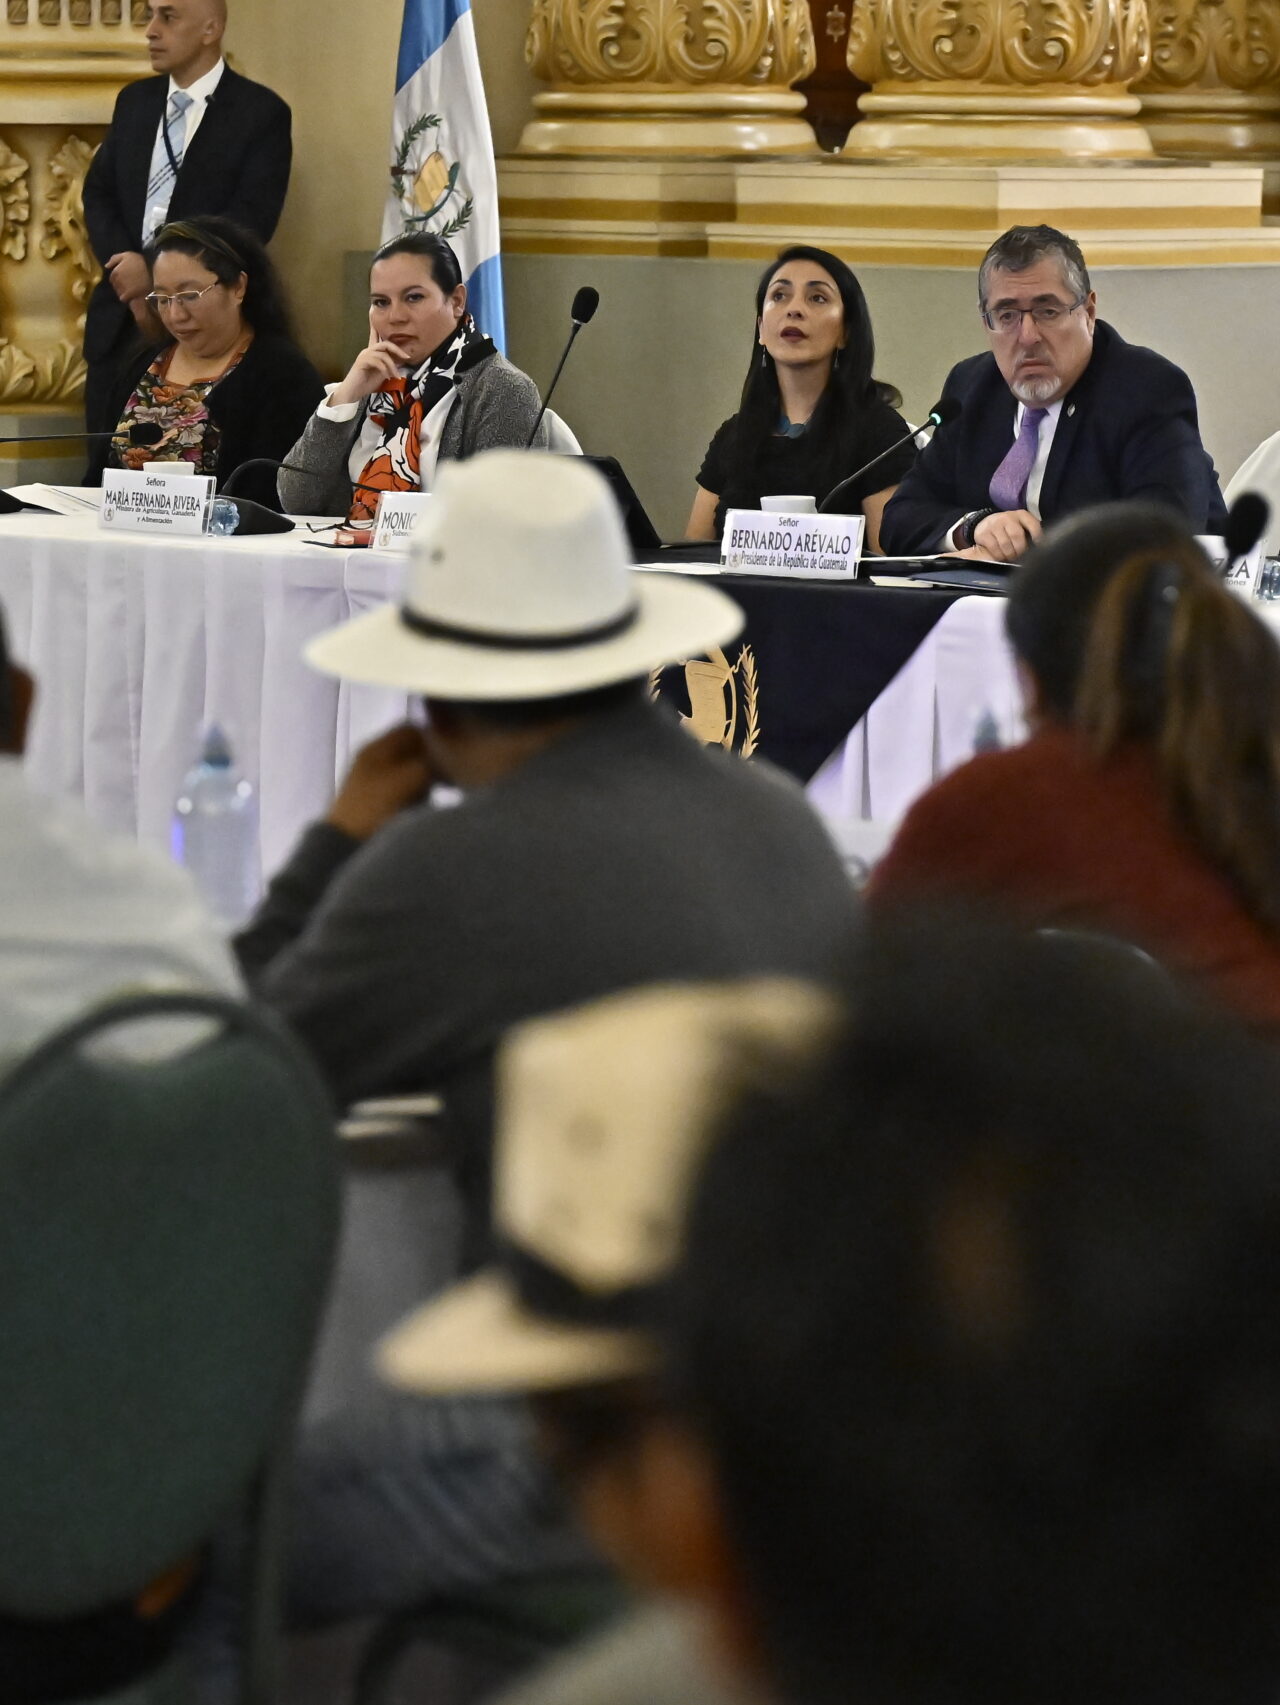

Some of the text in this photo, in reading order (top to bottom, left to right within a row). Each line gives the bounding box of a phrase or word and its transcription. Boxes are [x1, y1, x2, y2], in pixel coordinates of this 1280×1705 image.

[146, 477, 166, 487] Señora
[105, 488, 201, 511] MARÍA FERNANDA RIVERA
[778, 517, 799, 527] Señor
[731, 529, 851, 555] BERNARDO ARÉVALO
[741, 550, 848, 571] Presidente de la República de Guatemala
